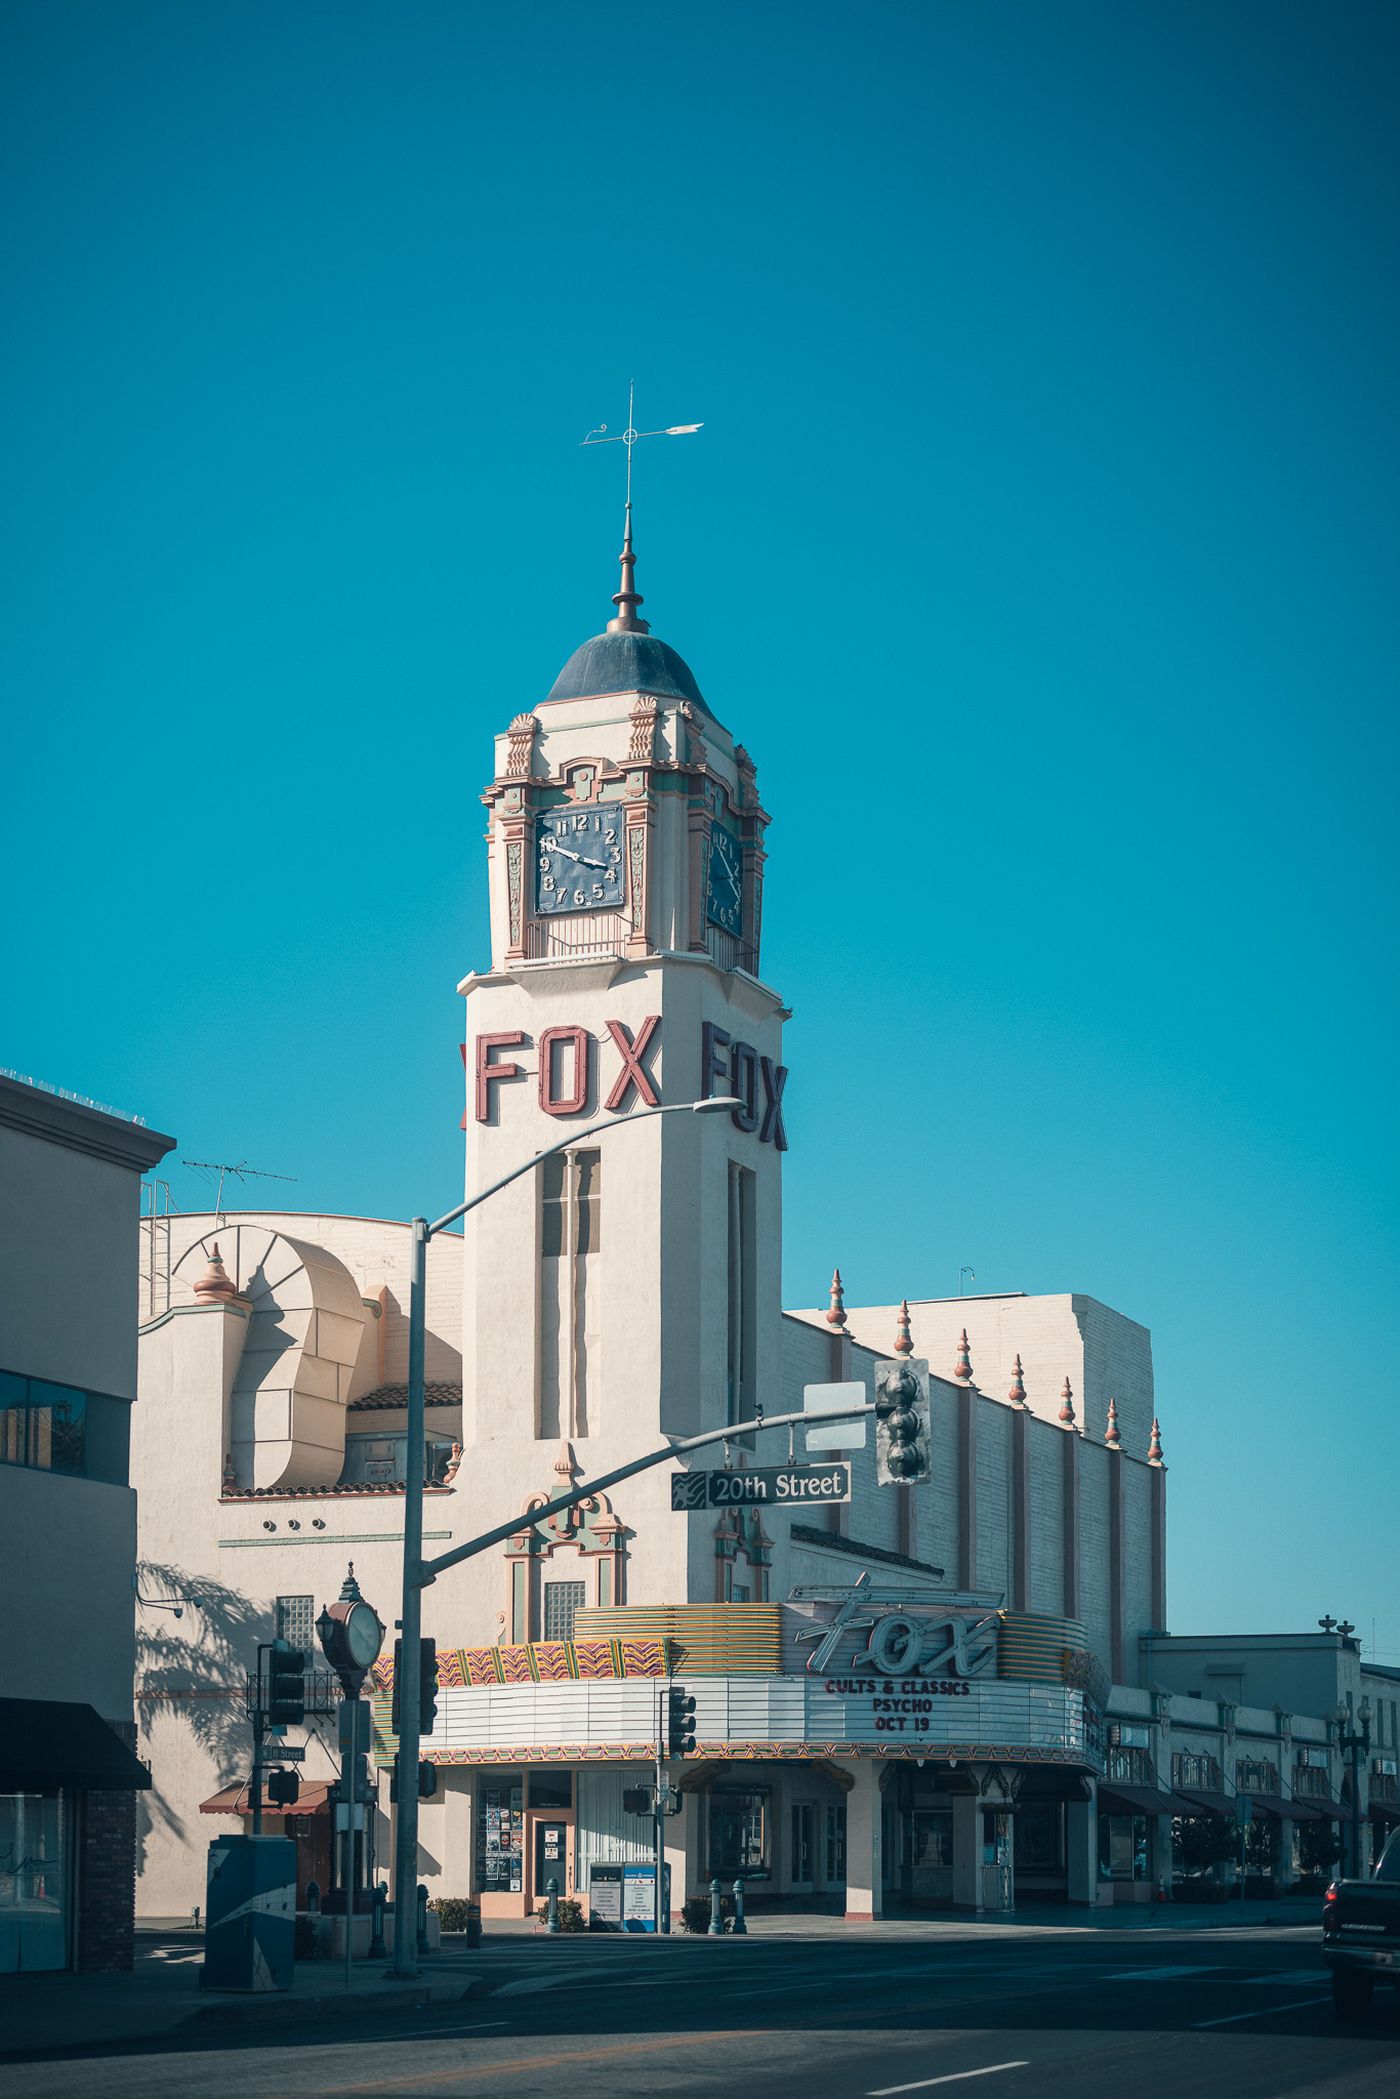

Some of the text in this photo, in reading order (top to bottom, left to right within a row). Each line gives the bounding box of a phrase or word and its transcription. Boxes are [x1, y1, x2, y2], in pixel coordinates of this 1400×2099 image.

[557, 820, 568, 837] 11
[573, 814, 588, 832] 12
[594, 816, 601, 831] 1
[540, 836, 557, 853] 10
[604, 828, 615, 845] 2
[719, 832, 727, 851] 12
[610, 847, 621, 864] 3
[540, 857, 550, 873] 9
[734, 862, 740, 878] 2
[543, 875, 555, 891] 8
[604, 867, 616, 883] 4
[556, 887, 567, 904] 7
[574, 889, 585, 905] 6
[592, 883, 604, 899] 5
[475, 1015, 662, 1122] FOX
[702, 1020, 789, 1152] FOX
[715, 1471, 842, 1501] 20th Street
[825, 1680, 970, 1696] CULTS & CLASSICS
[873, 1698, 933, 1713] PSYCHO
[875, 1717, 930, 1732] OCT 19
[280, 1749, 303, 1759] Street
